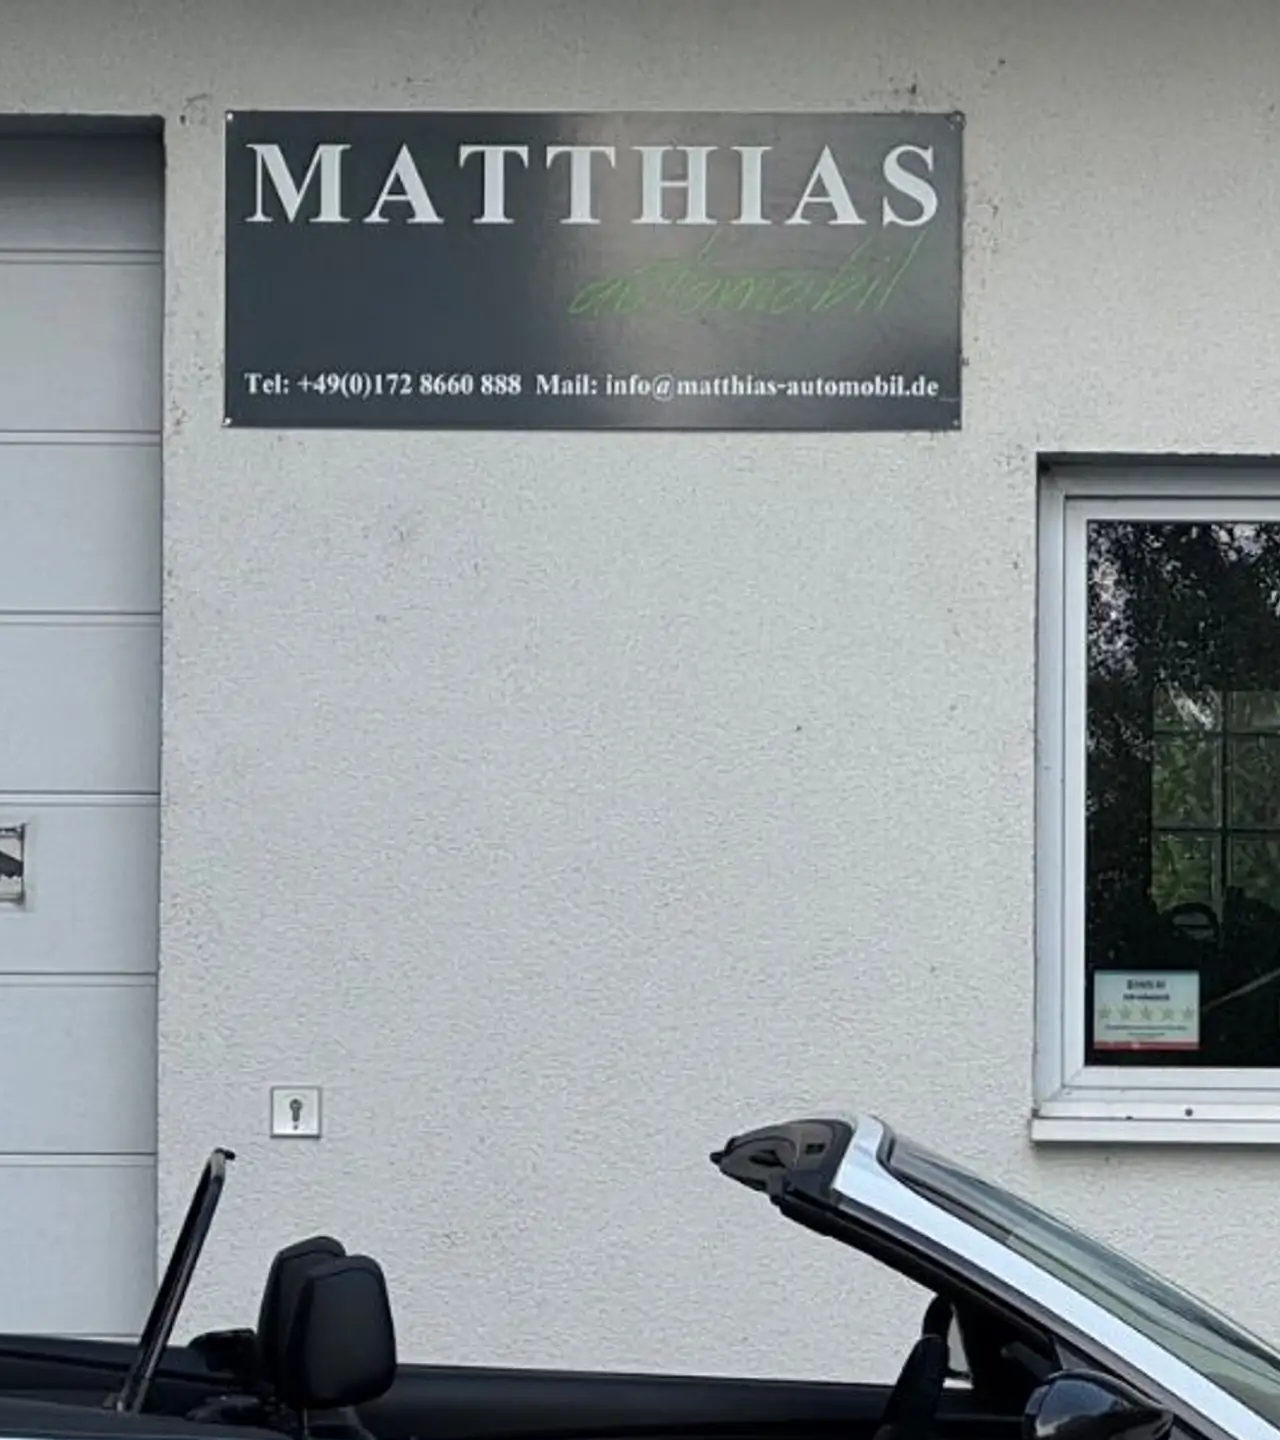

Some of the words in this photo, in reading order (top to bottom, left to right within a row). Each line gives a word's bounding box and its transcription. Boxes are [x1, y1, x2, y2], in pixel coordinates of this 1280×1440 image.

[245, 143, 938, 227] MATTHIAS
[244, 372, 289, 395] Tel:
[297, 372, 413, 399] +49(0)172
[419, 373, 473, 396] 8660
[480, 373, 522, 396] 888
[536, 374, 598, 396] Mail:
[606, 374, 940, 400] info@matthias-automobil.de
